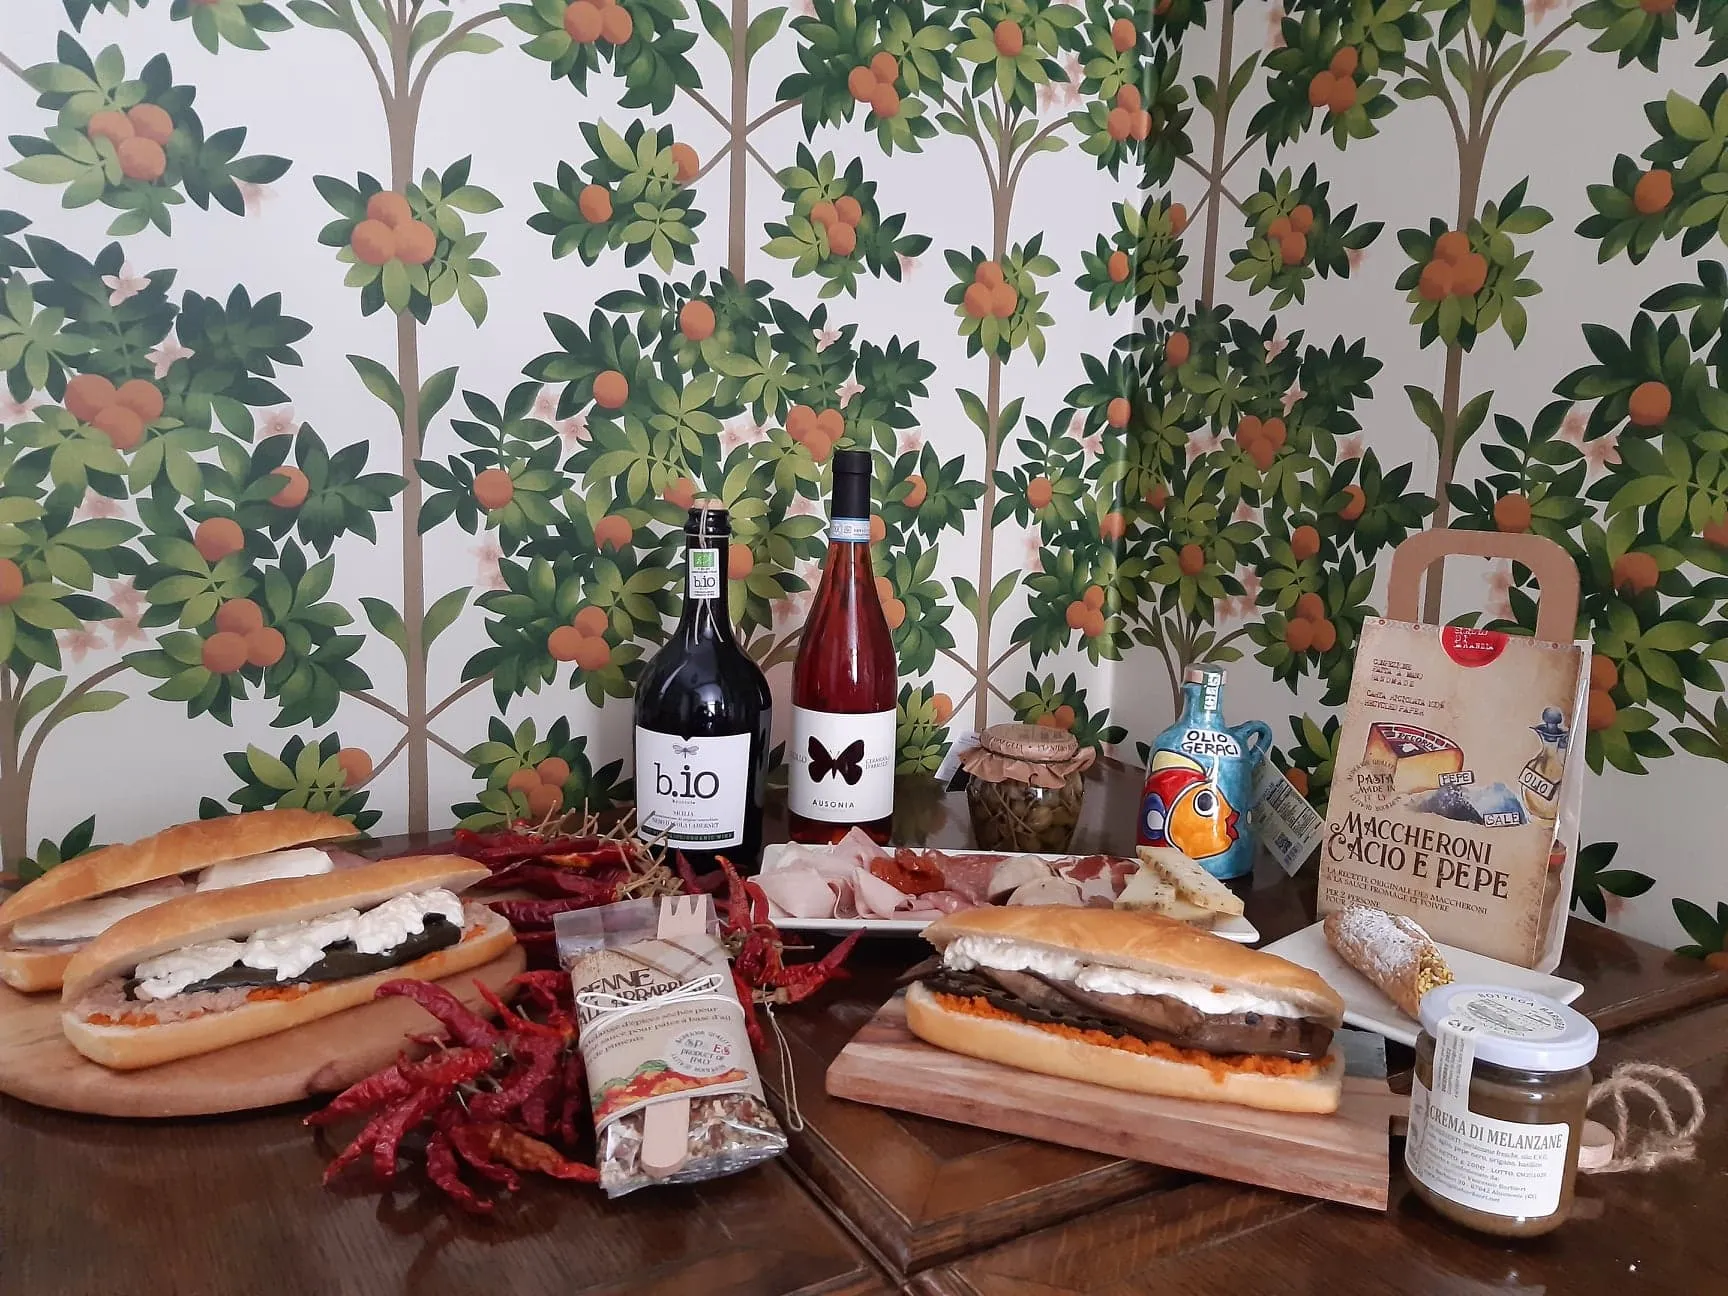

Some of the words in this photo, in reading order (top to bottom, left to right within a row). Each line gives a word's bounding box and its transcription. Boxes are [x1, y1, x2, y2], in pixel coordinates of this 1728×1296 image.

[693, 575, 716, 588] b.io
[1187, 731, 1228, 743] OLIO
[1181, 742, 1238, 756] GERACI
[654, 762, 720, 799] b.io
[1357, 773, 1394, 786] PASTA
[1442, 772, 1470, 784] PEPE
[1524, 772, 1549, 794] OLIO
[812, 799, 855, 808] AUSONIA
[1364, 794, 1387, 802] ITLY
[1486, 813, 1520, 825] SALE
[1330, 811, 1493, 865] MACCHERONI
[1327, 832, 1406, 871] CACIO
[1413, 852, 1429, 878] E
[1436, 857, 1510, 899] PEPE
[1326, 887, 1339, 896] PER
[1420, 899, 1449, 912] POIVRE
[1430, 894, 1488, 914] MACCHERONI
[1430, 1105, 1466, 1135] CREMA
[1469, 1124, 1484, 1141] DI
[1486, 1129, 1563, 1150] MELANZANE
